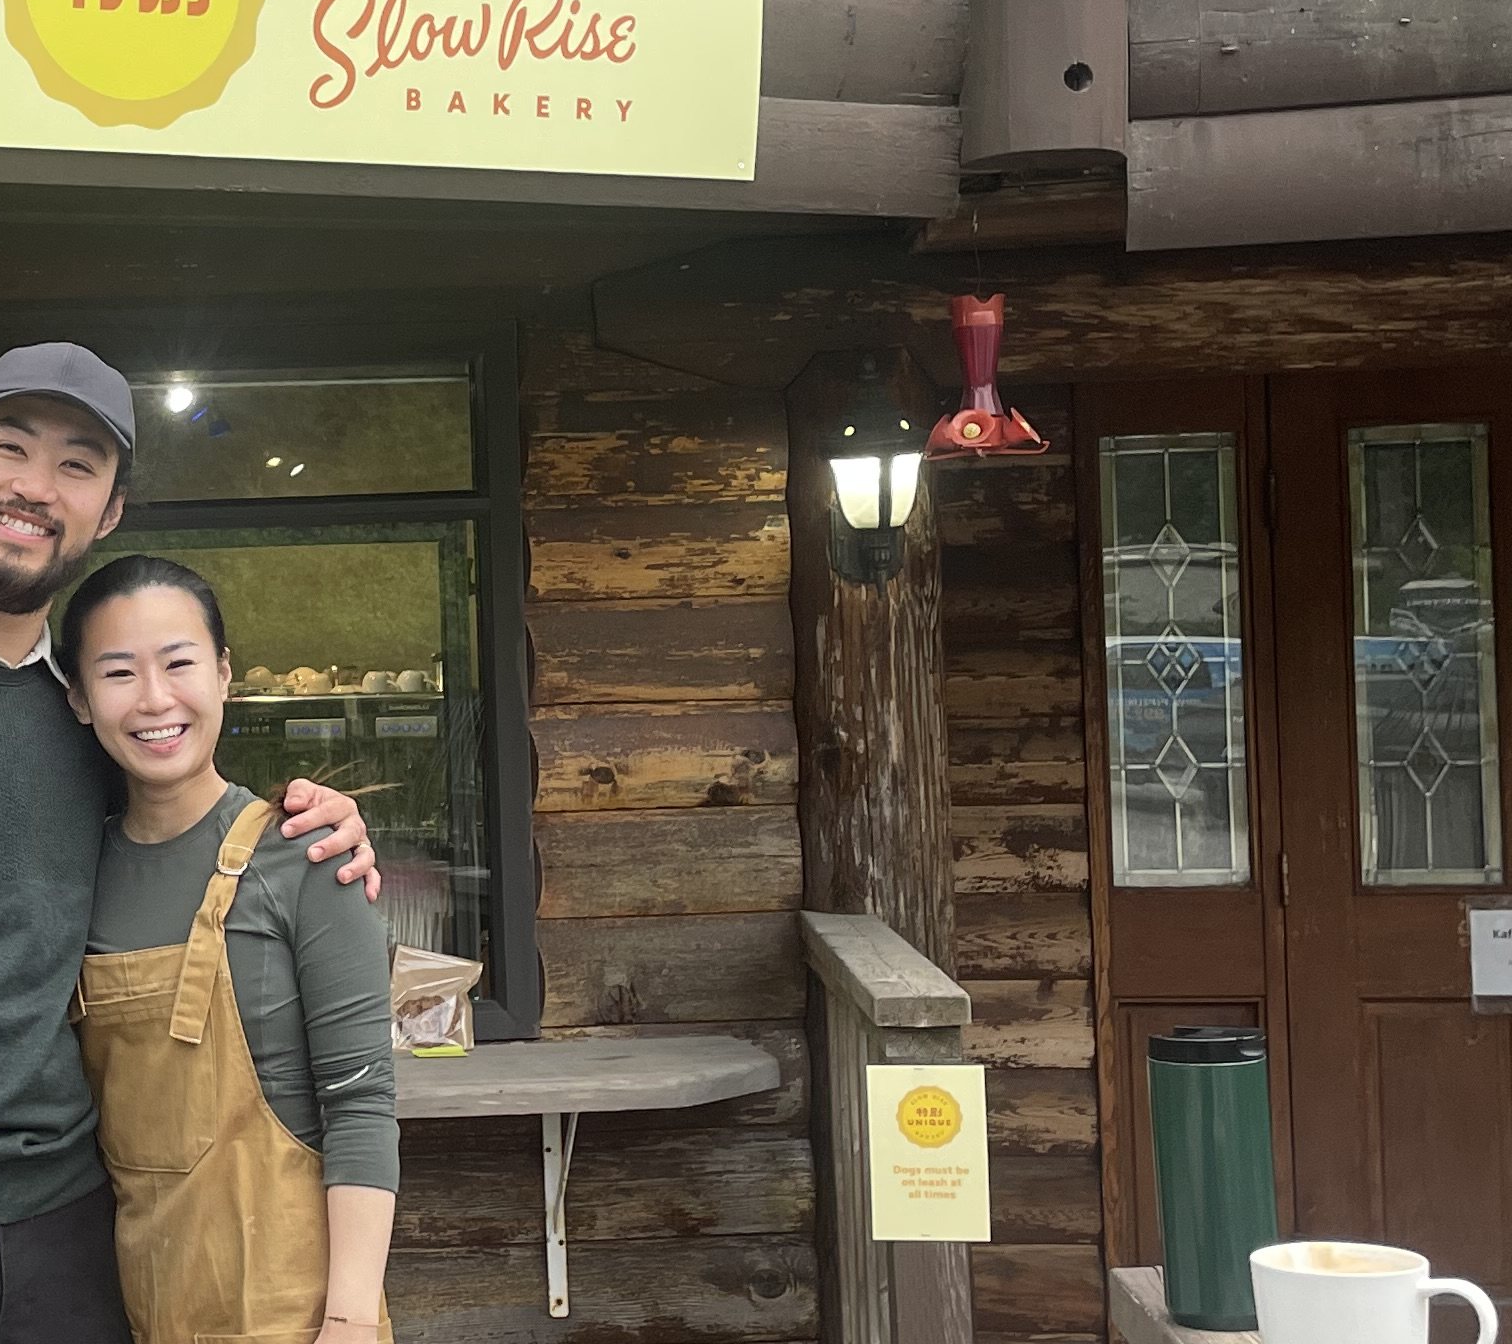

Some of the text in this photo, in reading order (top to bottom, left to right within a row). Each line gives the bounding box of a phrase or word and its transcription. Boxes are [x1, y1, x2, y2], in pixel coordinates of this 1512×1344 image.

[406, 88, 632, 122] BAKERY
[893, 1165, 970, 1176] Dogs must be
[919, 1178, 948, 1186] leash
[951, 1178, 961, 1186] at
[909, 1190, 957, 1199] all times
